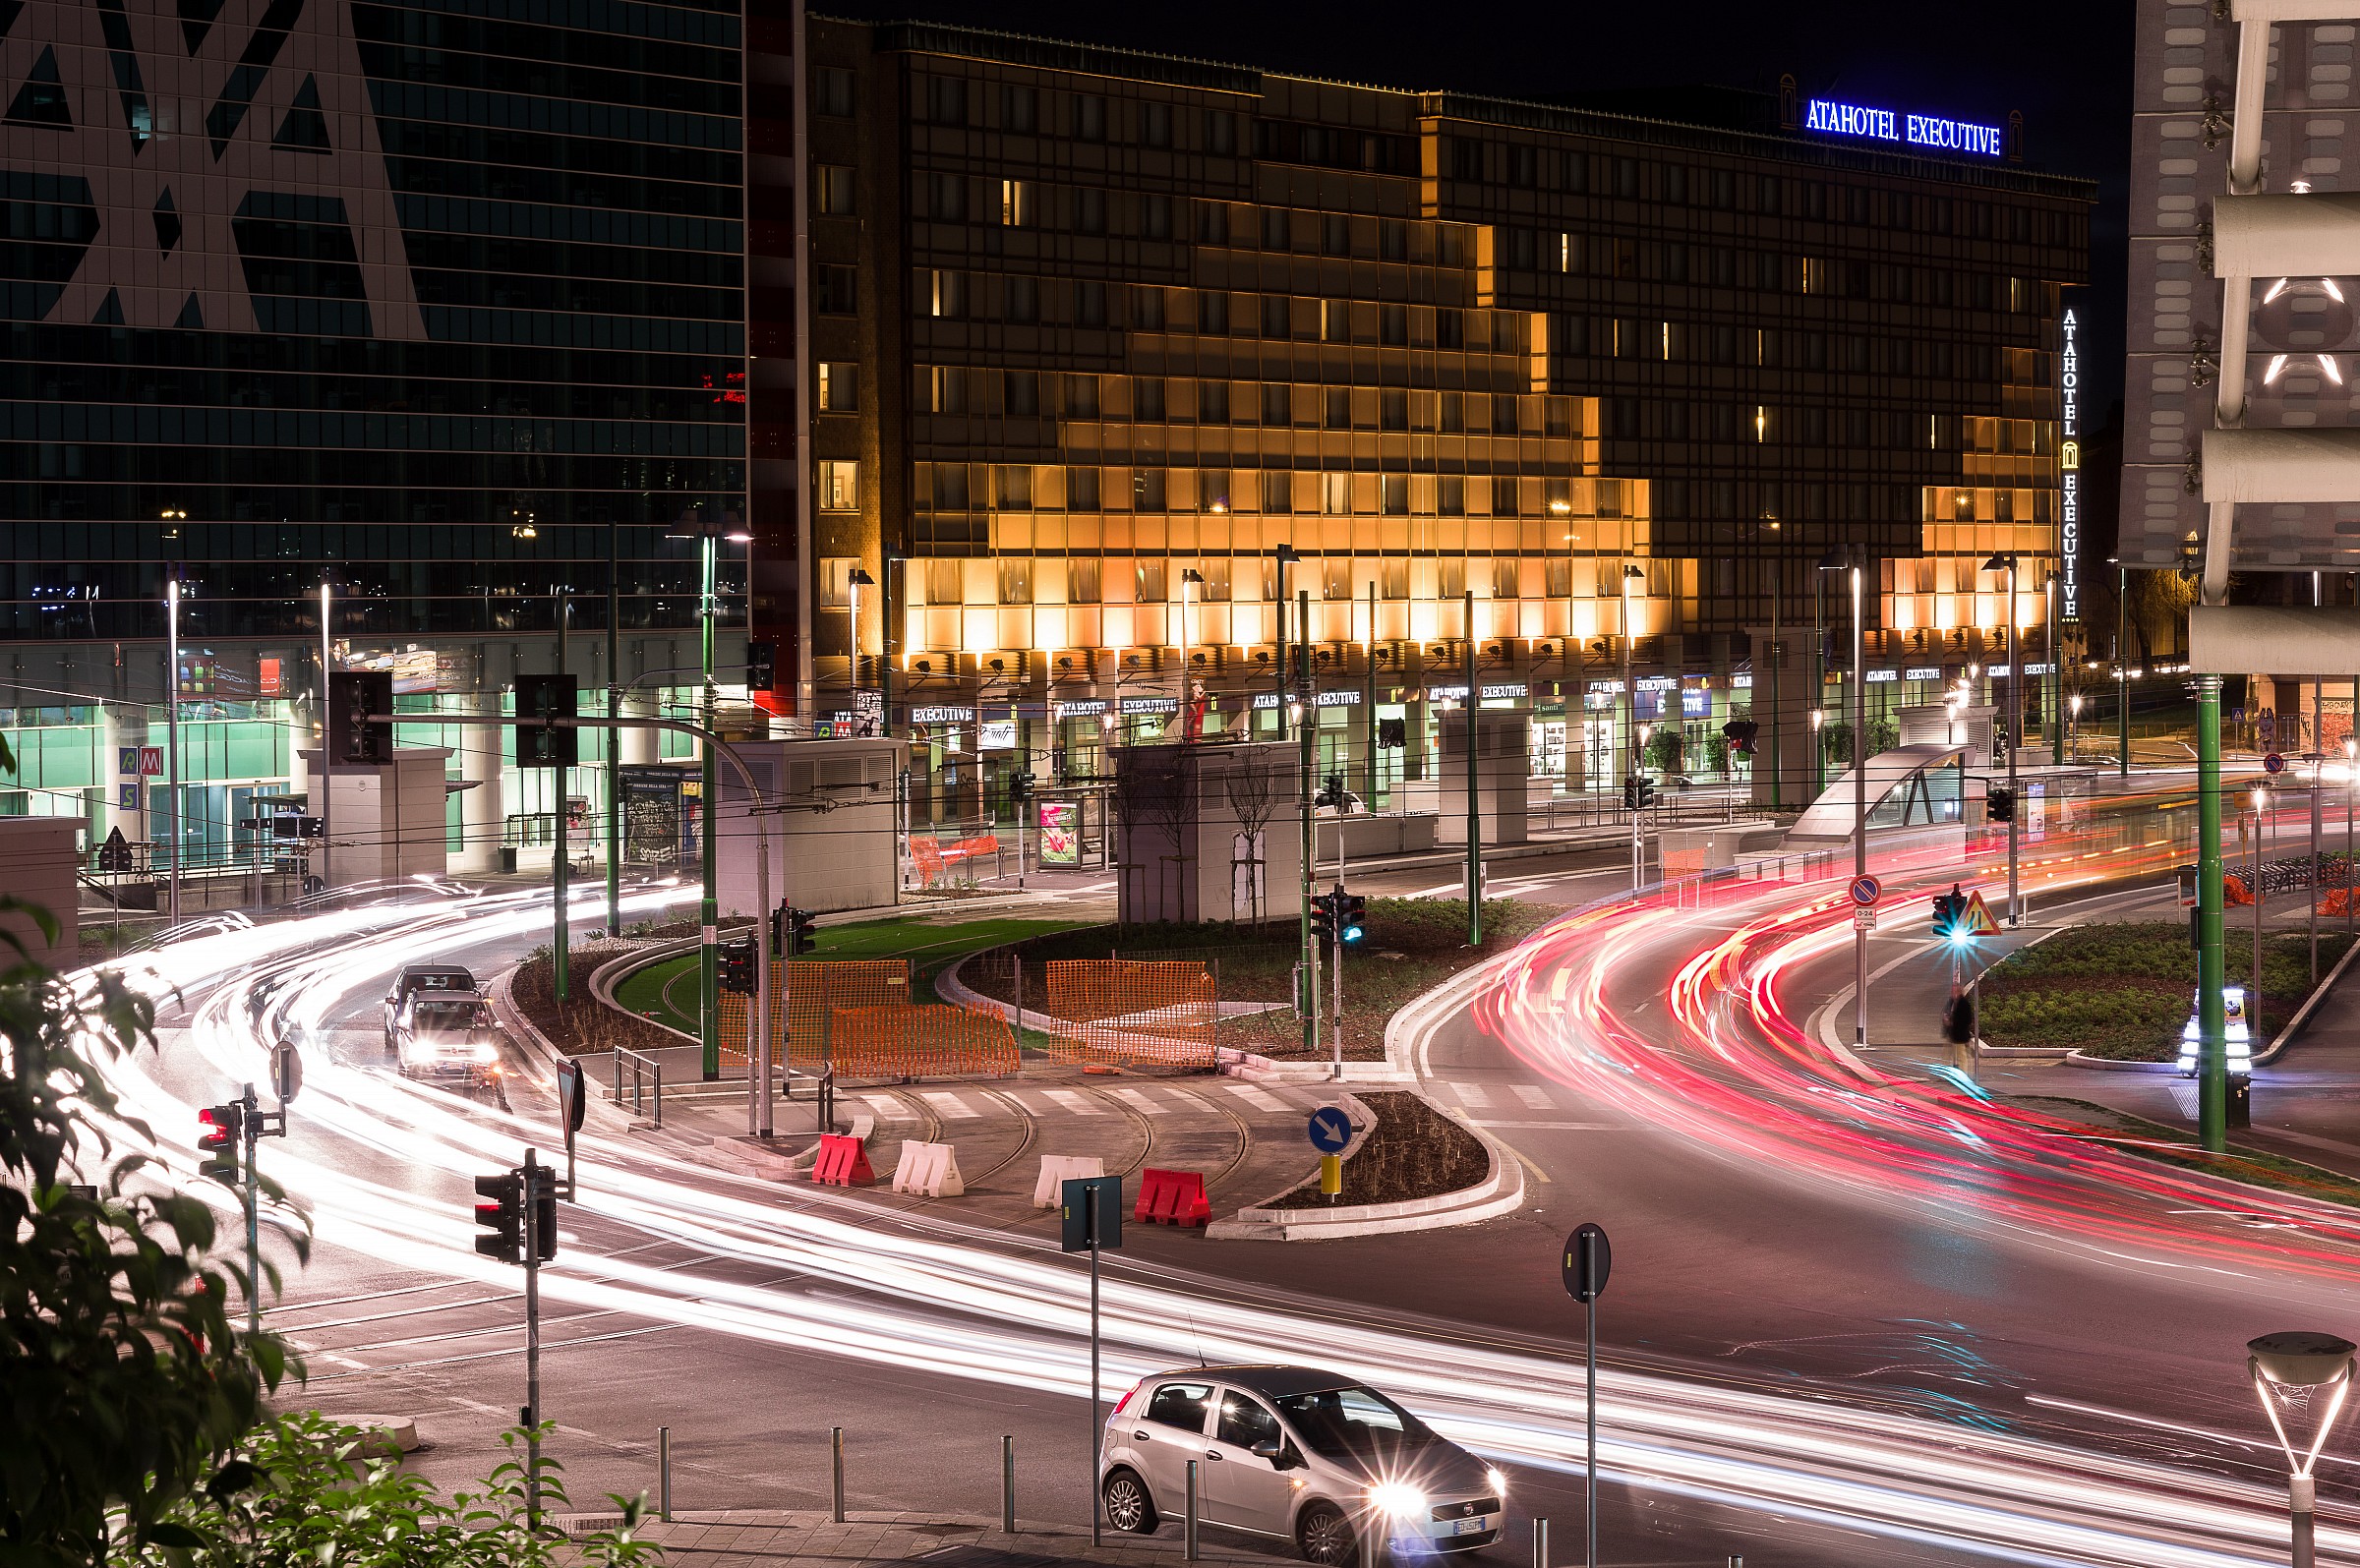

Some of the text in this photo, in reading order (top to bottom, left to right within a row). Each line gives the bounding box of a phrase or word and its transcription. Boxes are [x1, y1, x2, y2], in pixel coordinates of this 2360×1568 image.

[1806, 99, 2000, 156] ATAHOTEL EXECUTIVE
[2063, 309, 2077, 436] ATAHOTEL
[2063, 475, 2077, 616] EXECUTIVE
[1866, 668, 1940, 681] ATAHOTEL EXECUTIVE
[2025, 664, 2055, 674] EXECUTVE
[1482, 685, 1527, 698] EXECUTIVE
[1636, 678, 1678, 691] EXECUTIVE
[1123, 698, 1177, 713] EXECUTIVE
[913, 707, 973, 723] EXECUTIVE
[121, 751, 136, 770] R
[142, 752, 159, 770] M
[122, 788, 135, 807] S
